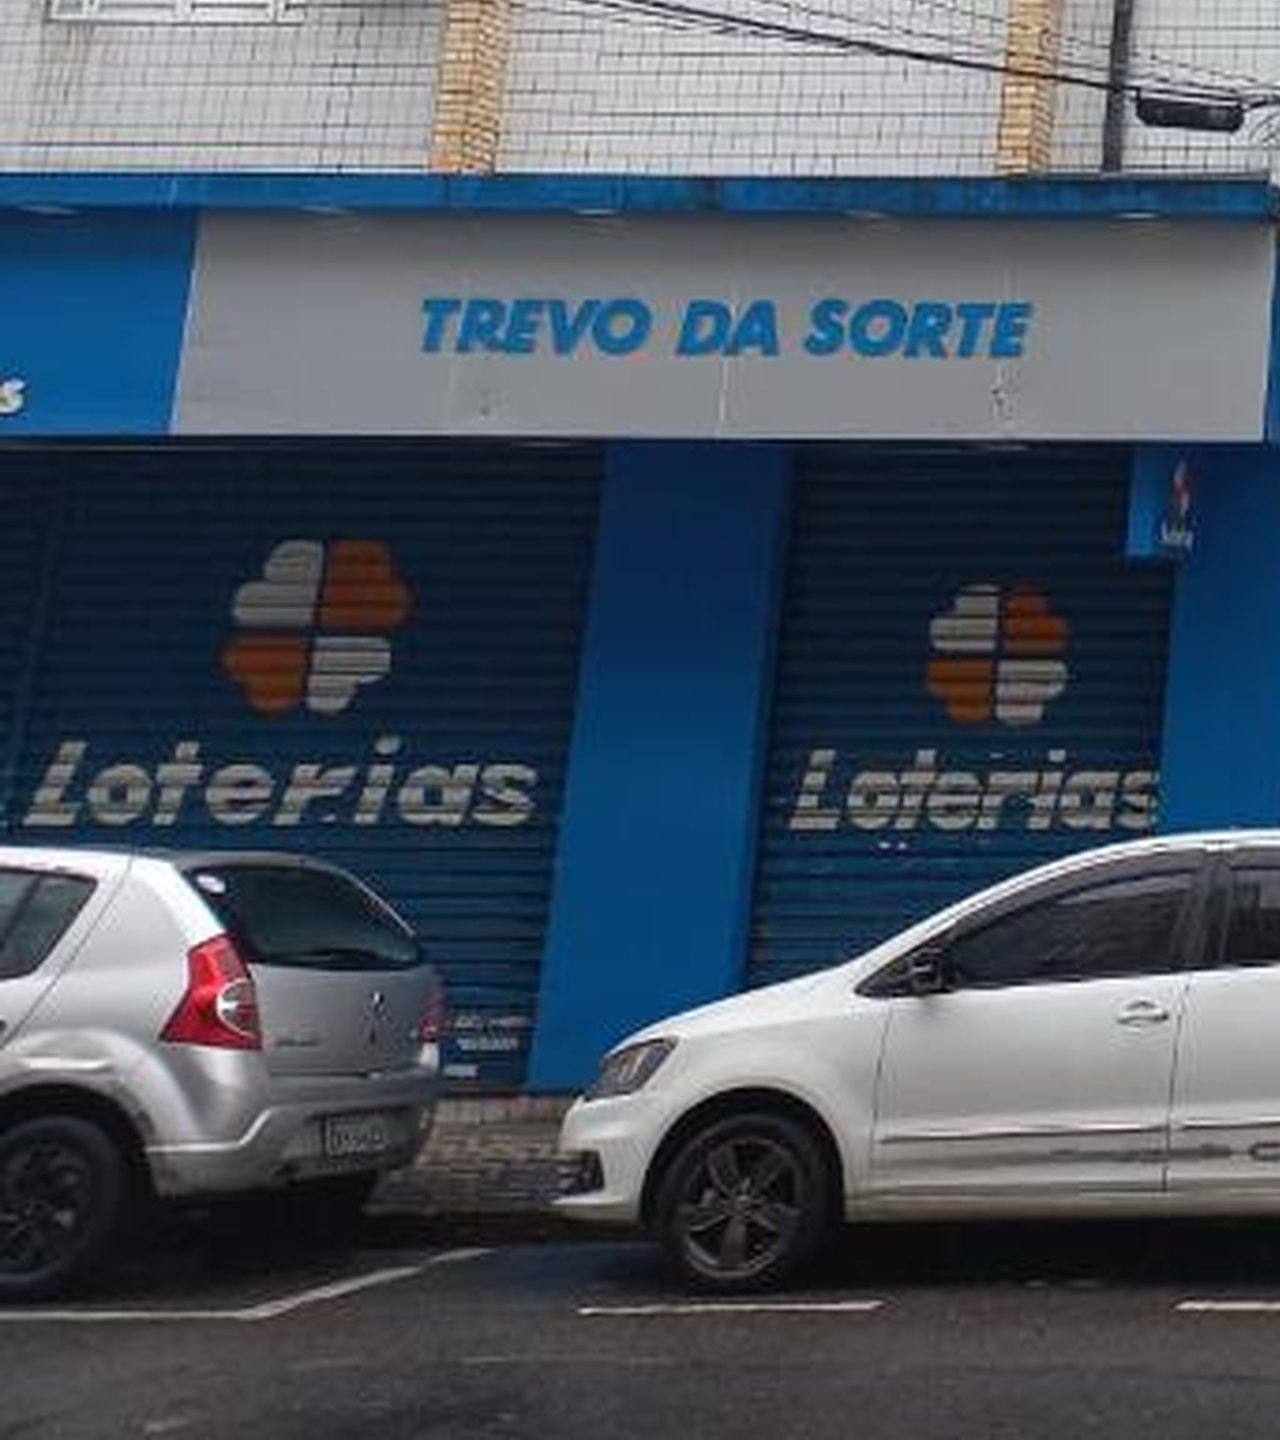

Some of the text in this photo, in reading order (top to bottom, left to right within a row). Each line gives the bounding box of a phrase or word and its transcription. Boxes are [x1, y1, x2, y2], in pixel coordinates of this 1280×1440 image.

[420, 297, 1034, 360] TREVO DA SORTE
[22, 736, 540, 828] Loterias
[788, 748, 1162, 833] Loterias
